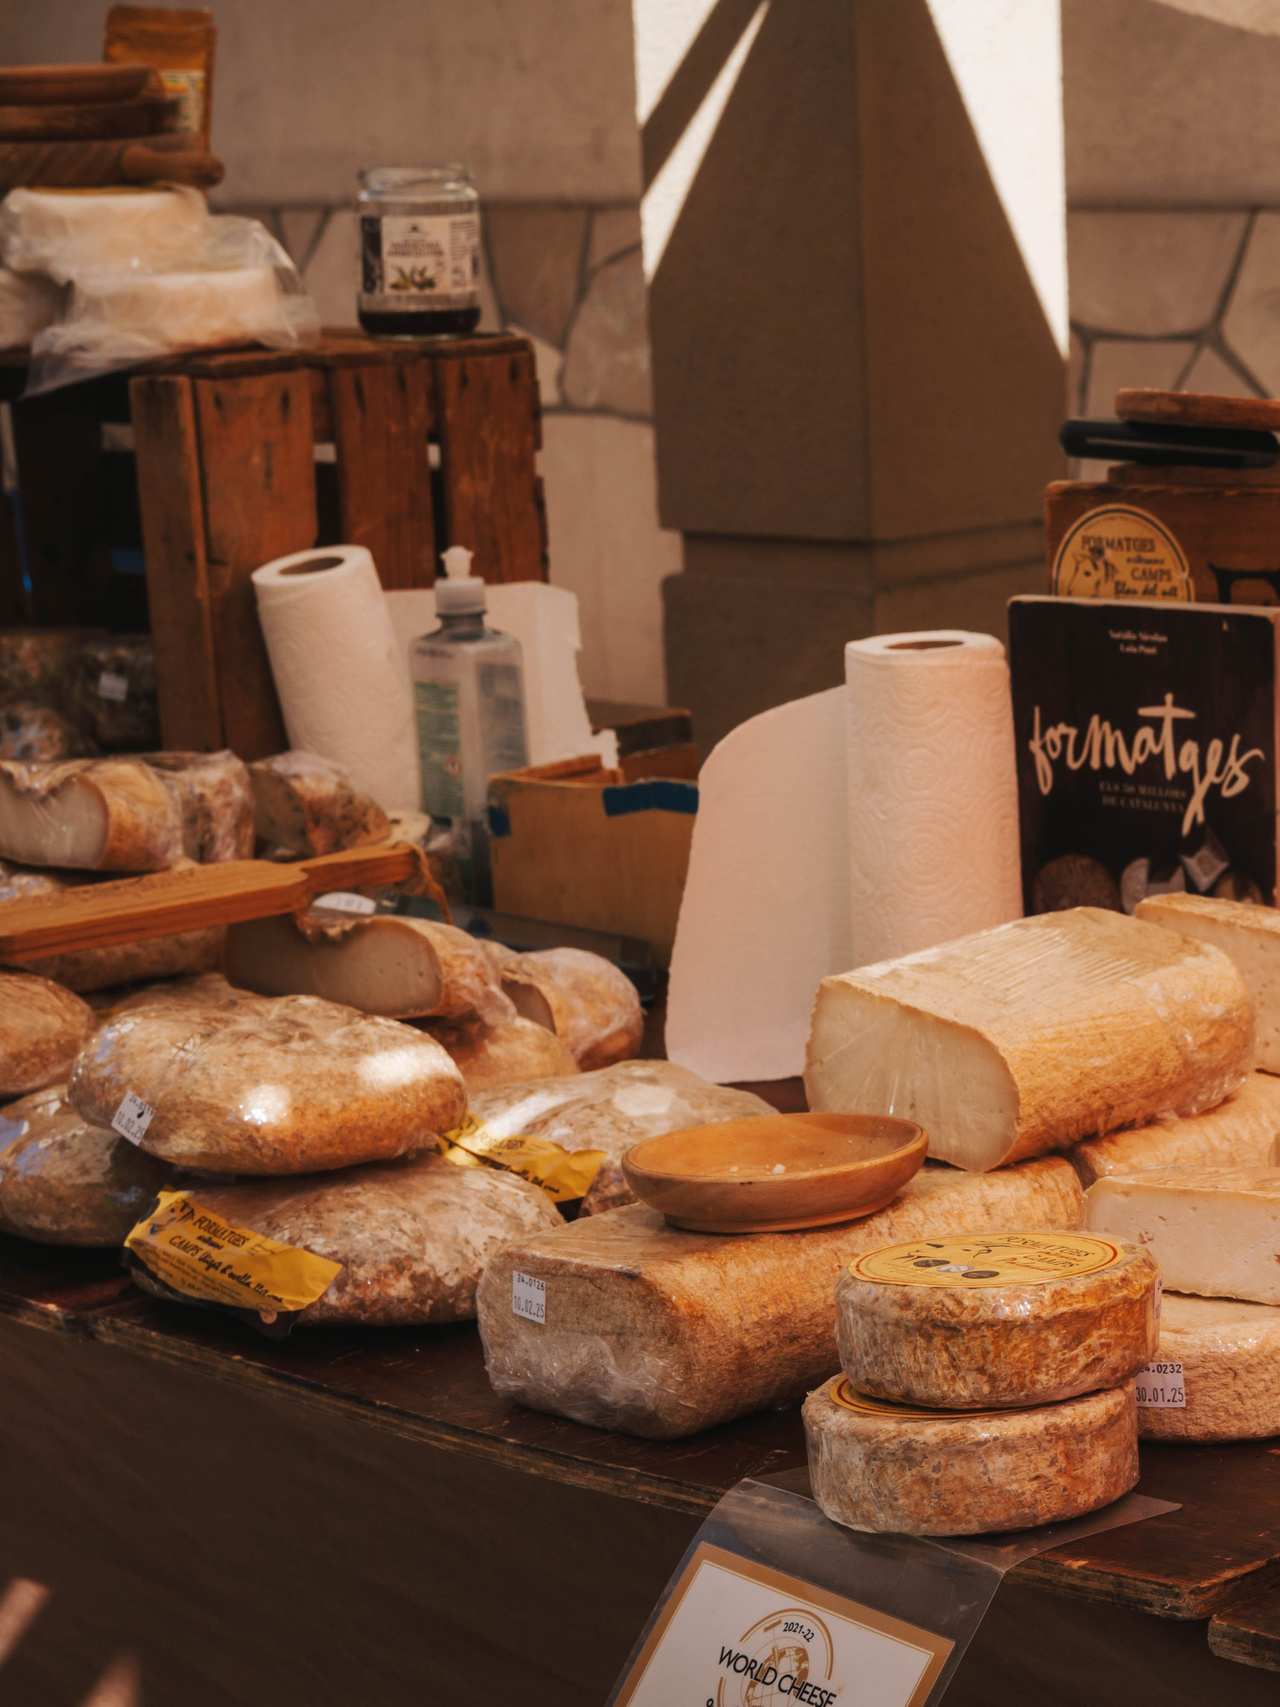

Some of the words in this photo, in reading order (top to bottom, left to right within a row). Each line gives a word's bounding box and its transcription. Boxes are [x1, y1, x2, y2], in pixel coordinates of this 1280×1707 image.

[1029, 692, 1266, 837] formatges
[193, 1215, 250, 1248] FORMATGES
[517, 1273, 545, 1291] 24.0126
[514, 1295, 544, 1318] 10.02.25
[1136, 1386, 1184, 1403] 30.01.25
[783, 1621, 814, 1643] 2021-22
[719, 1645, 778, 1687] WORLD
[777, 1673, 837, 1707] CHEESE
